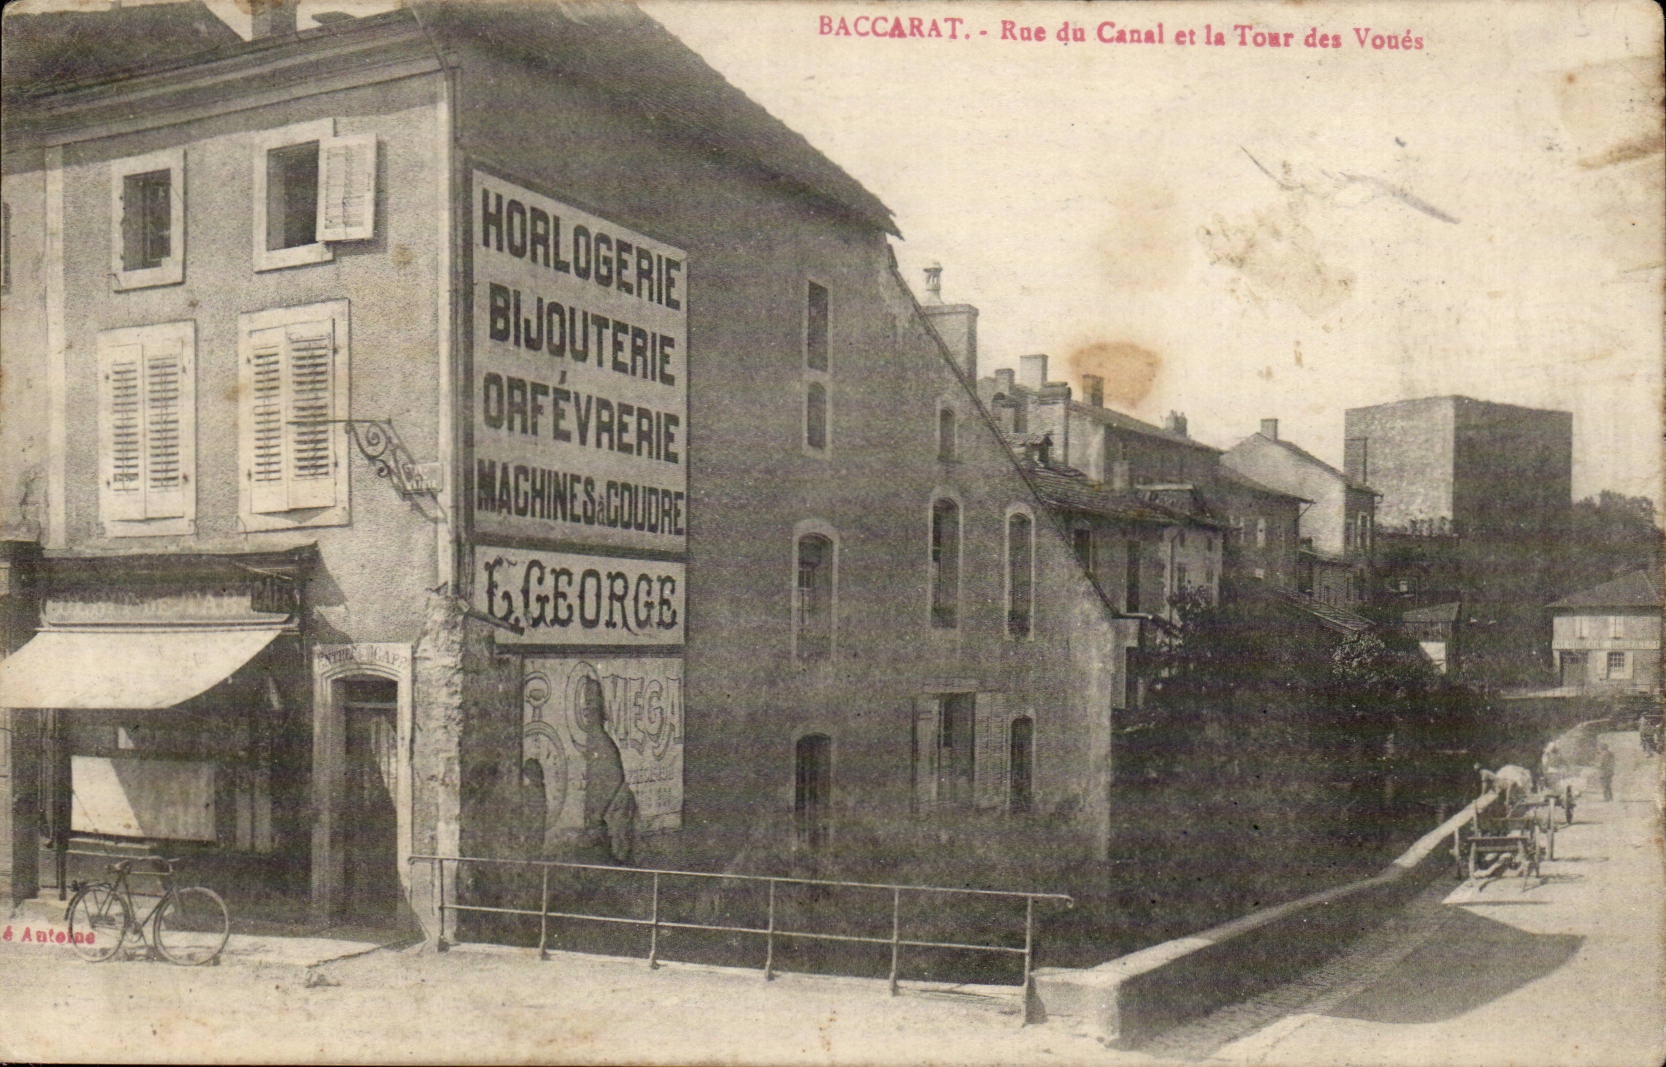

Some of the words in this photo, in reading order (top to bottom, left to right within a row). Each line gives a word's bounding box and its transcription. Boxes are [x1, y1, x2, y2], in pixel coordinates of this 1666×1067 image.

[482, 187, 682, 311] HORLOGERIE
[489, 282, 676, 386] BIJOUTERIE
[483, 370, 680, 464] ORFÉVRERIE
[476, 457, 596, 526] MACHINES
[606, 479, 685, 536] COUDRE
[519, 558, 680, 636] GEORGE
